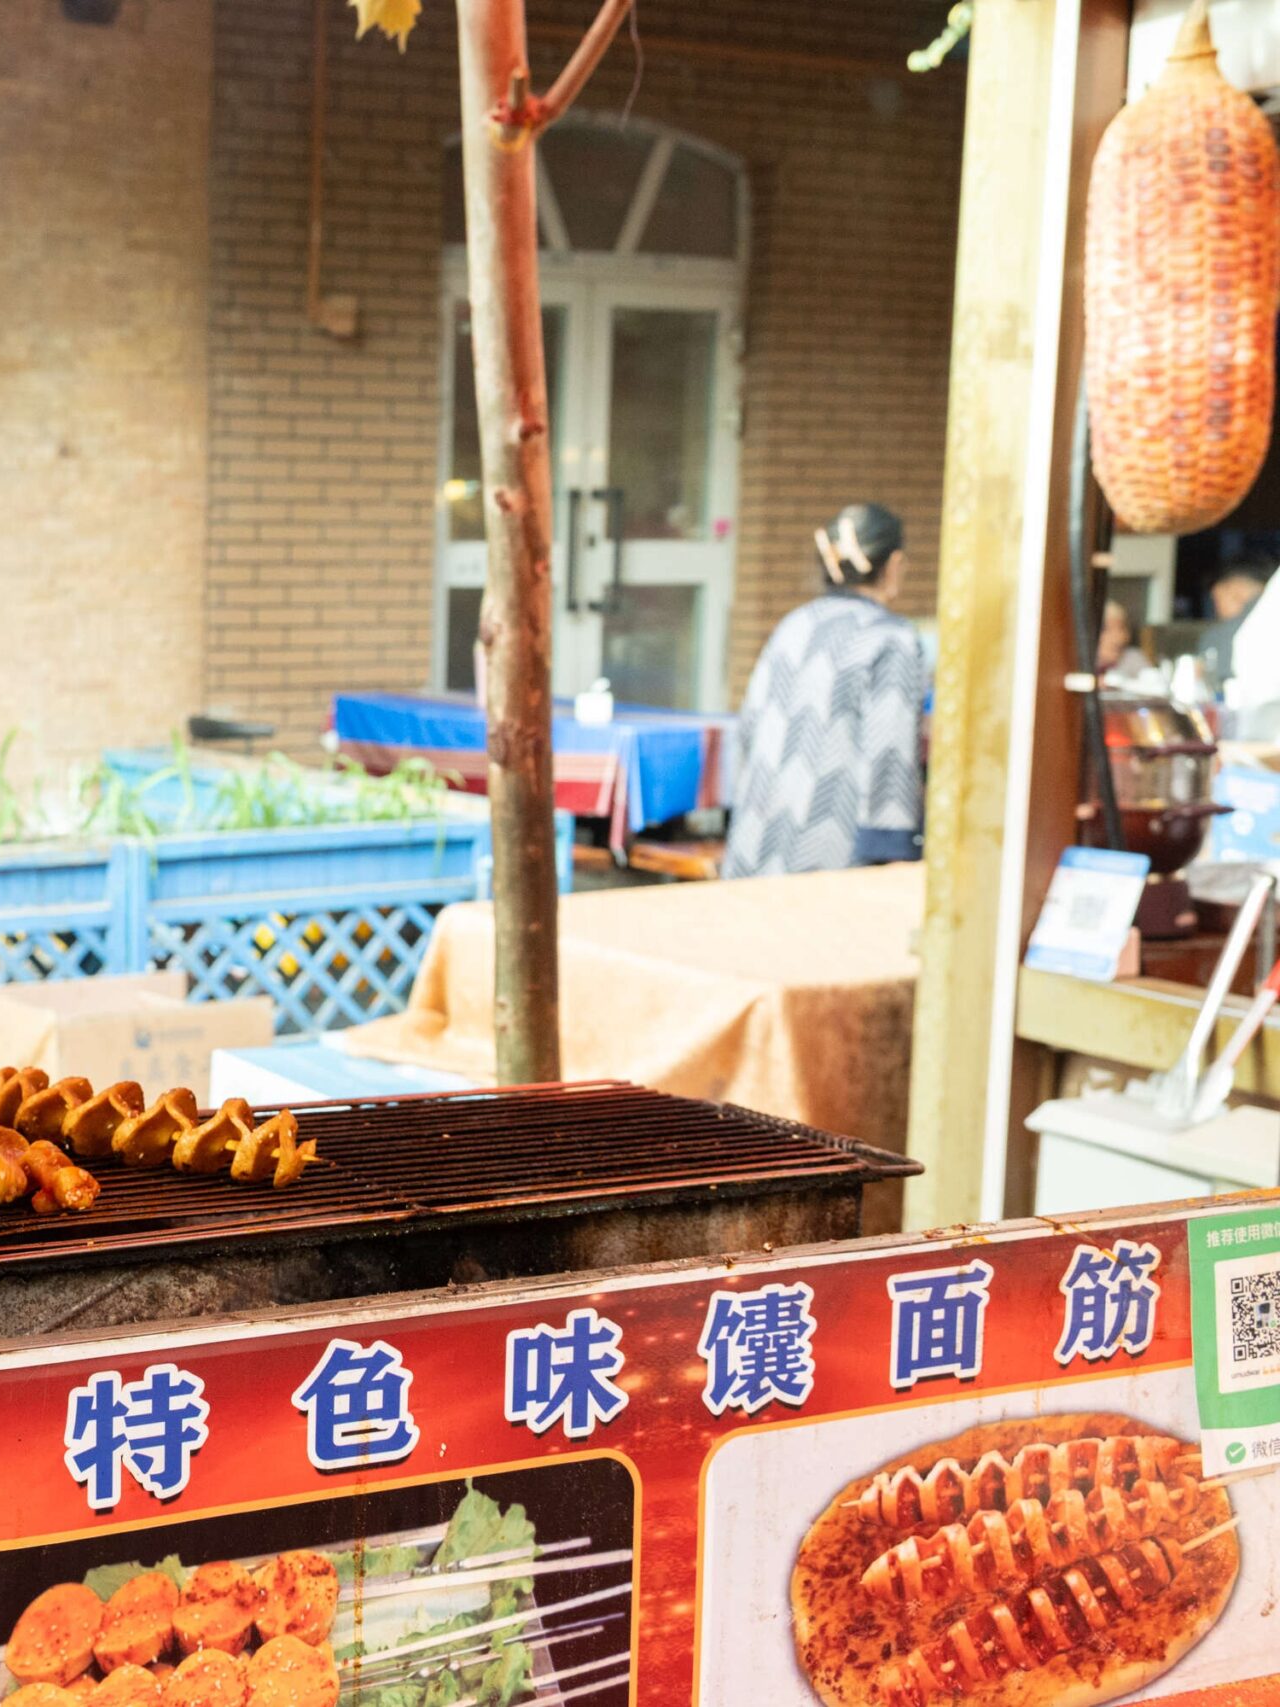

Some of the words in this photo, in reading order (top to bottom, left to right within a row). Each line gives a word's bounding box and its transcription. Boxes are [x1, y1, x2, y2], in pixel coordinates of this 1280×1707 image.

[65, 1240, 1160, 1508] 特色味馕面筋
